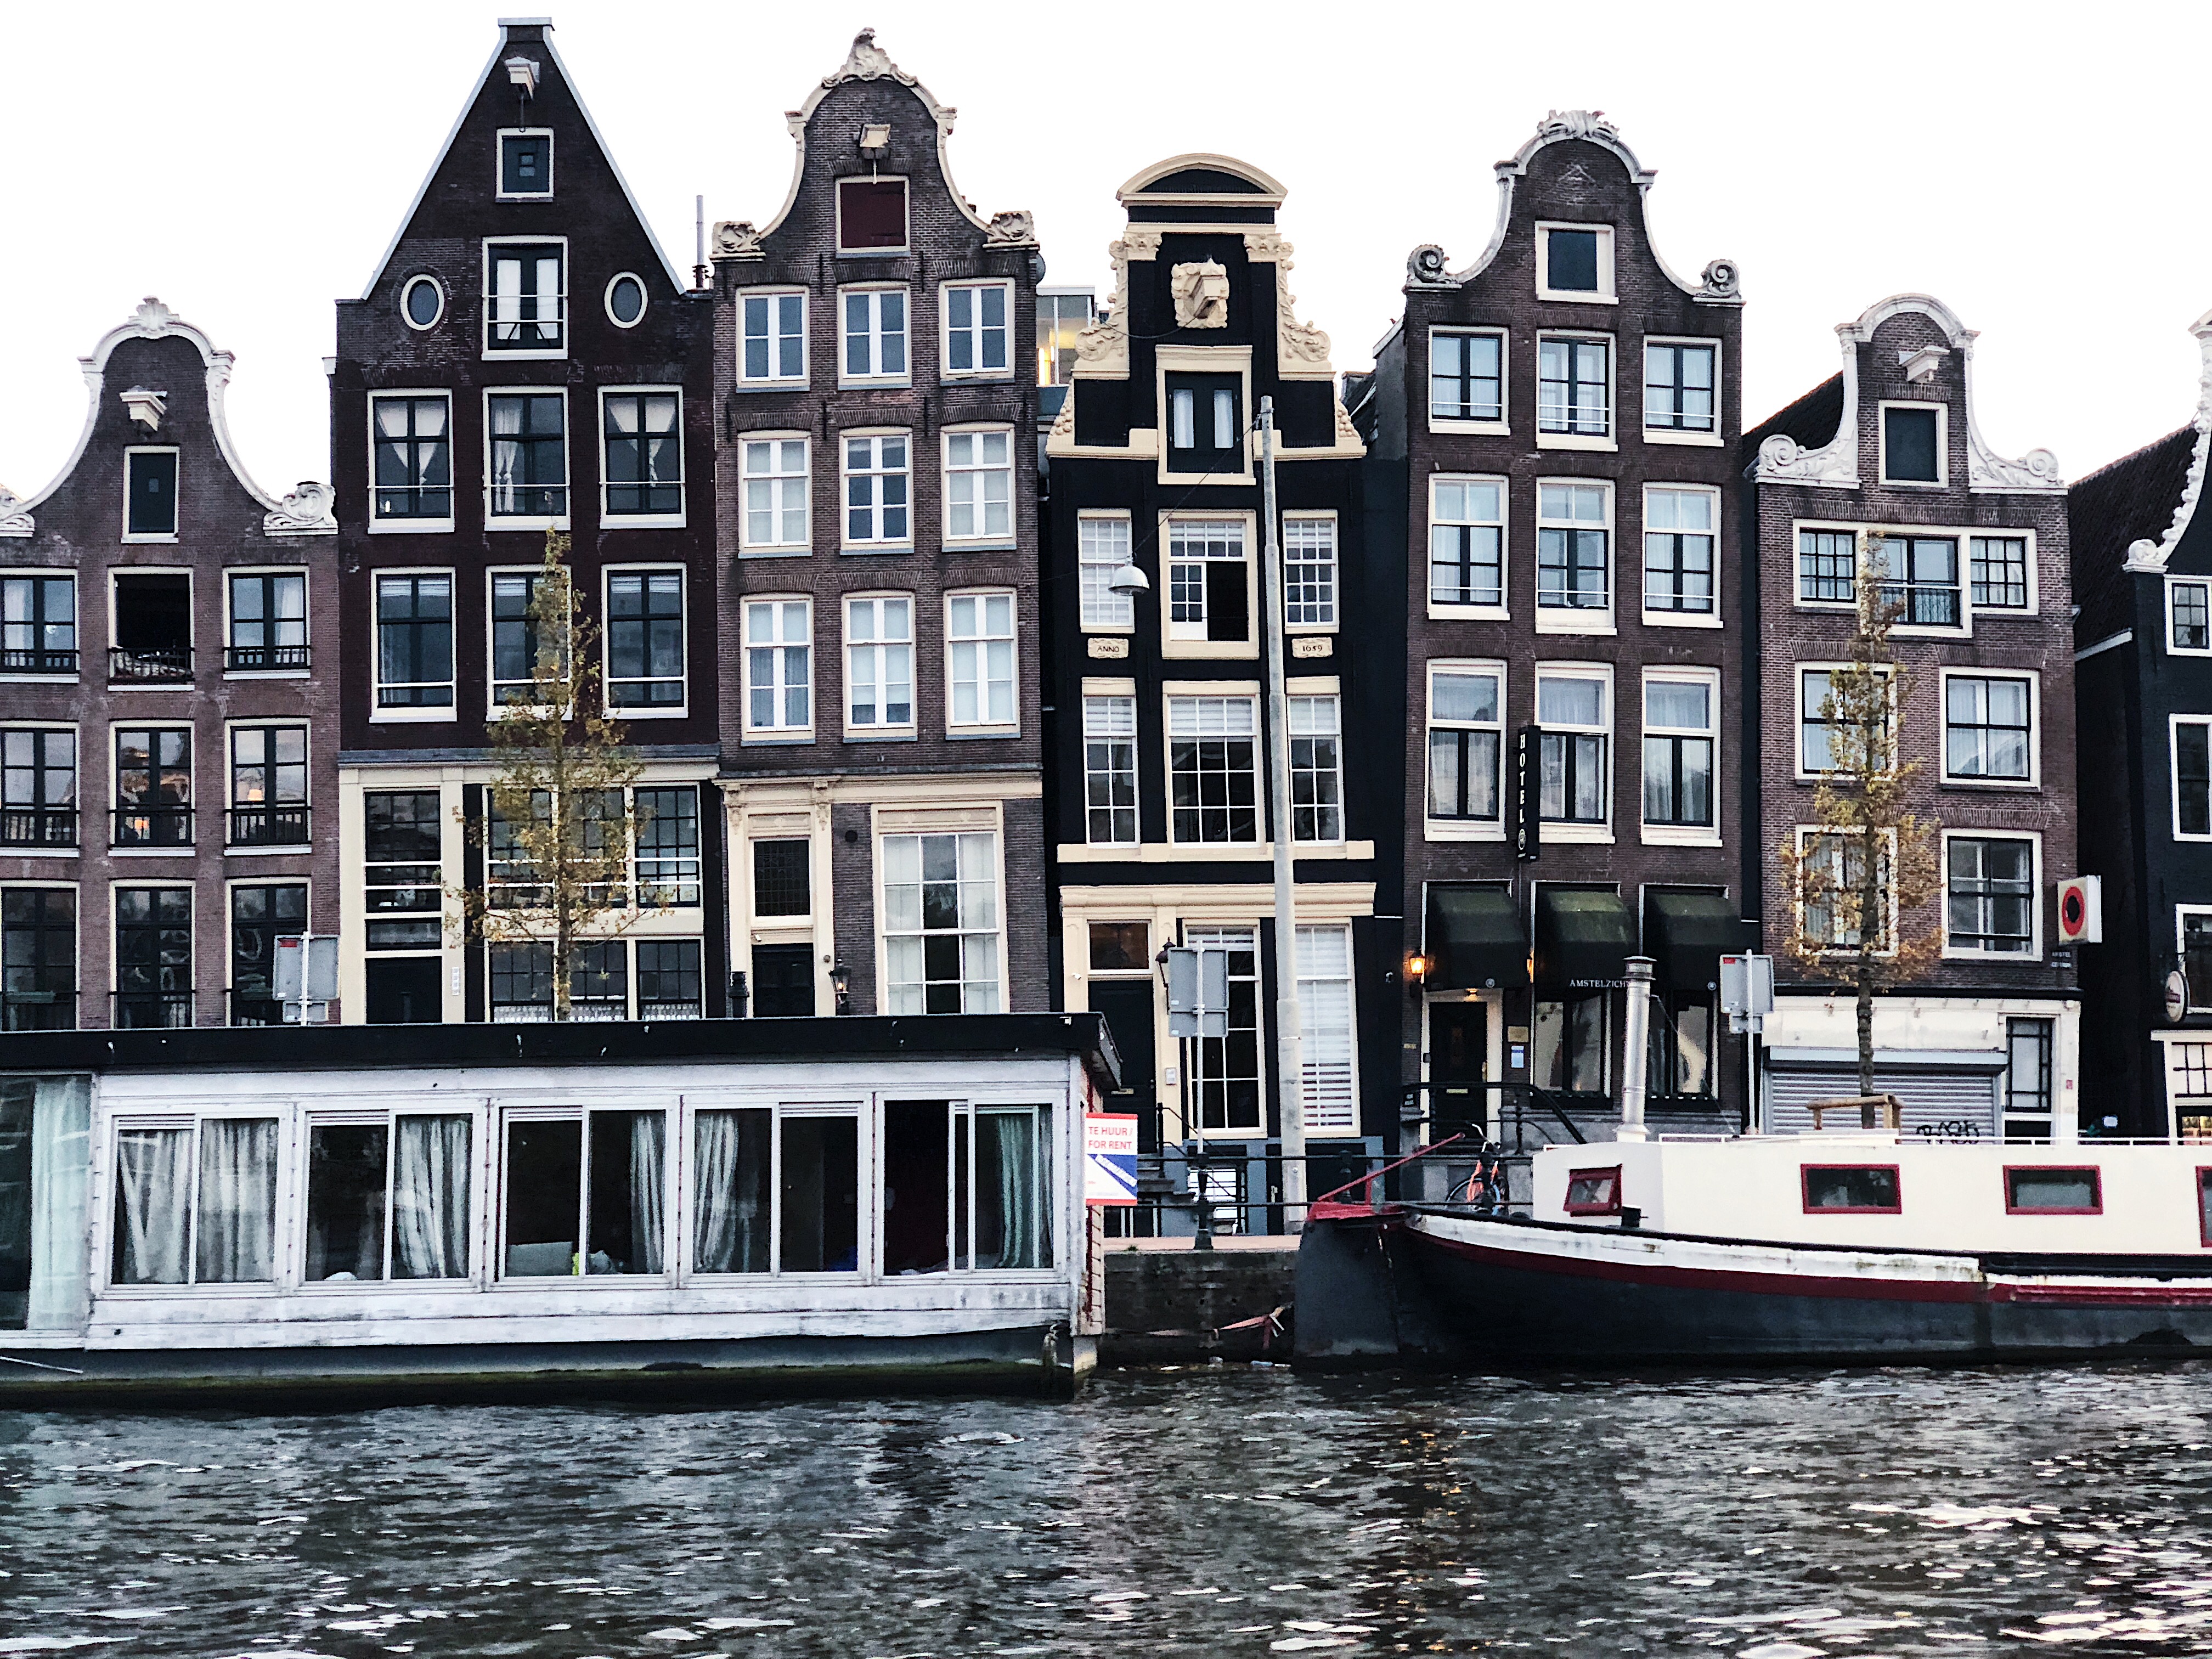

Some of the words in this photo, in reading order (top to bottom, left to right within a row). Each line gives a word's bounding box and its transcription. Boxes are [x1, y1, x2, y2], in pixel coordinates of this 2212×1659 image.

[1088, 1126, 1098, 1135] TE
[1088, 1140, 1106, 1149] FOR
[1108, 1141, 1132, 1149] RENT
